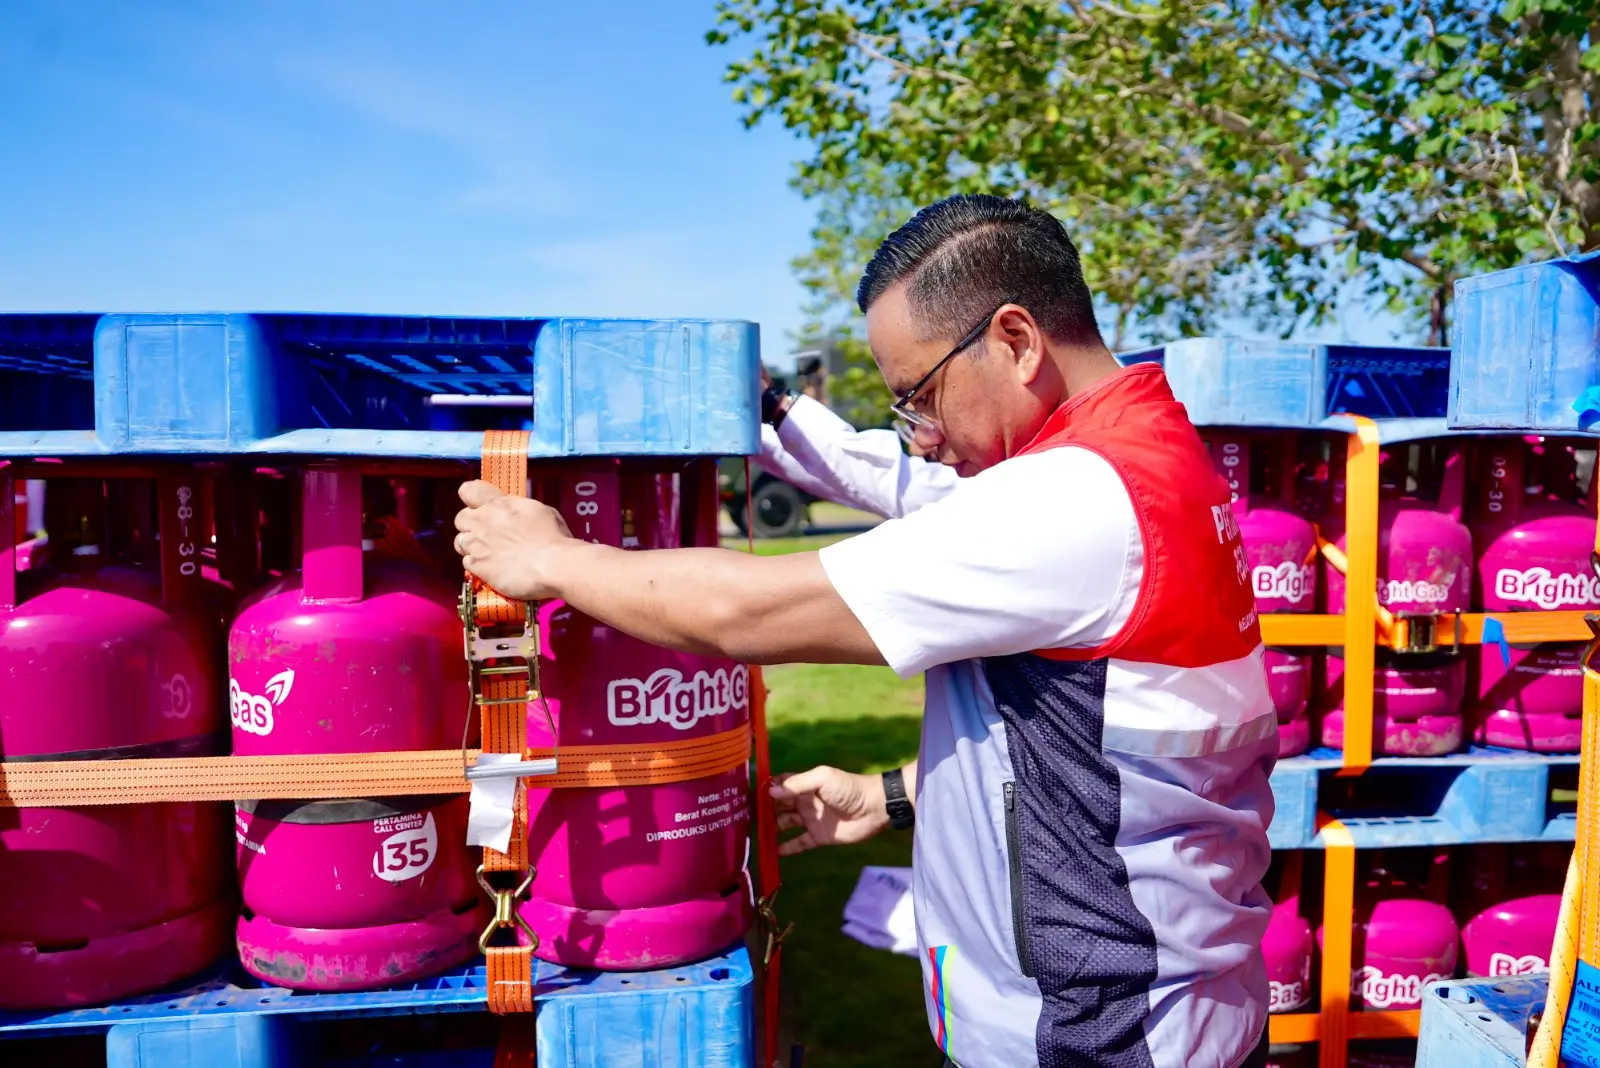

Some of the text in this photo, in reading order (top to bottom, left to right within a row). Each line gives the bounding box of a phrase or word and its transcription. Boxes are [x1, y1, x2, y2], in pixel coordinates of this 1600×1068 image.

[575, 481, 599, 544] 08-
[1498, 570, 1587, 606] Bright
[610, 671, 728, 727] Bright
[374, 813, 422, 826] PERTAMINA
[374, 819, 422, 833] CALL CENTER
[646, 816, 733, 843] DIPRODUKSI UNTUK
[675, 810, 700, 822] Berat
[378, 837, 429, 873] 135
